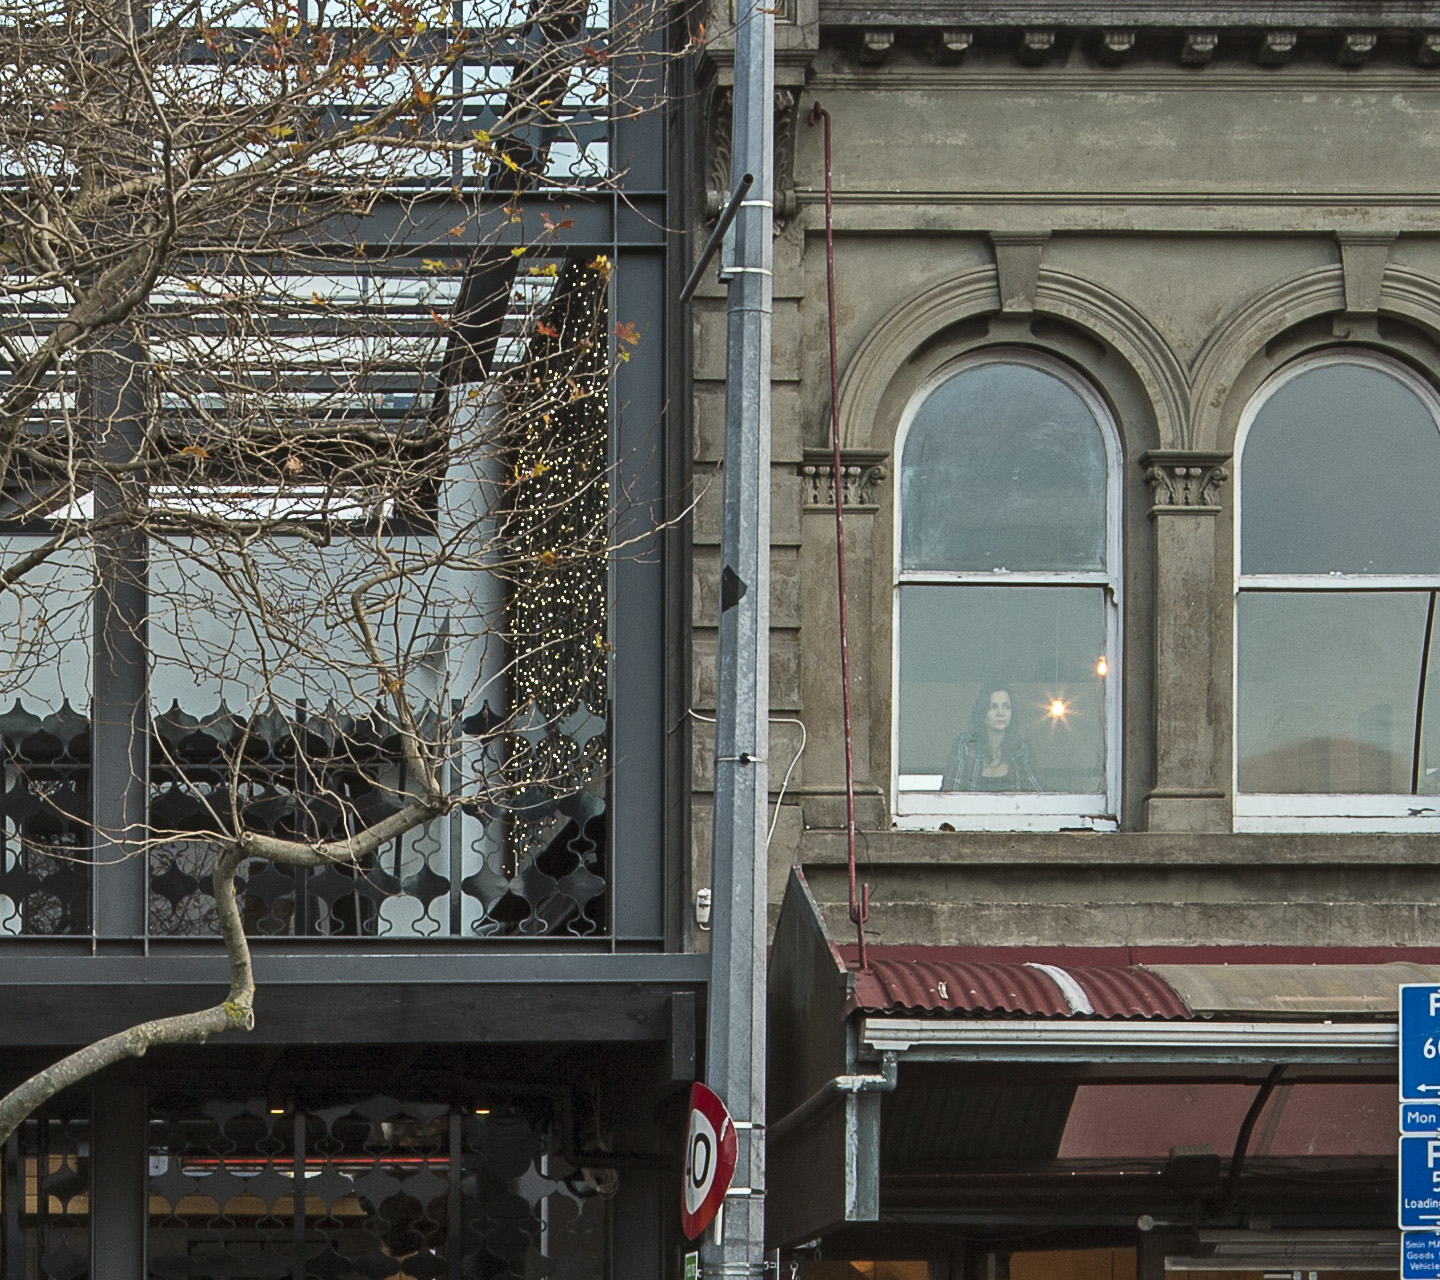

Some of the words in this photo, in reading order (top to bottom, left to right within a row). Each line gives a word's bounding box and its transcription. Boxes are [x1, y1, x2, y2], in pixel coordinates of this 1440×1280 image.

[1407, 1111, 1436, 1123] Mon
[686, 1132, 711, 1189] 40
[1406, 1251, 1435, 1259] Goods
